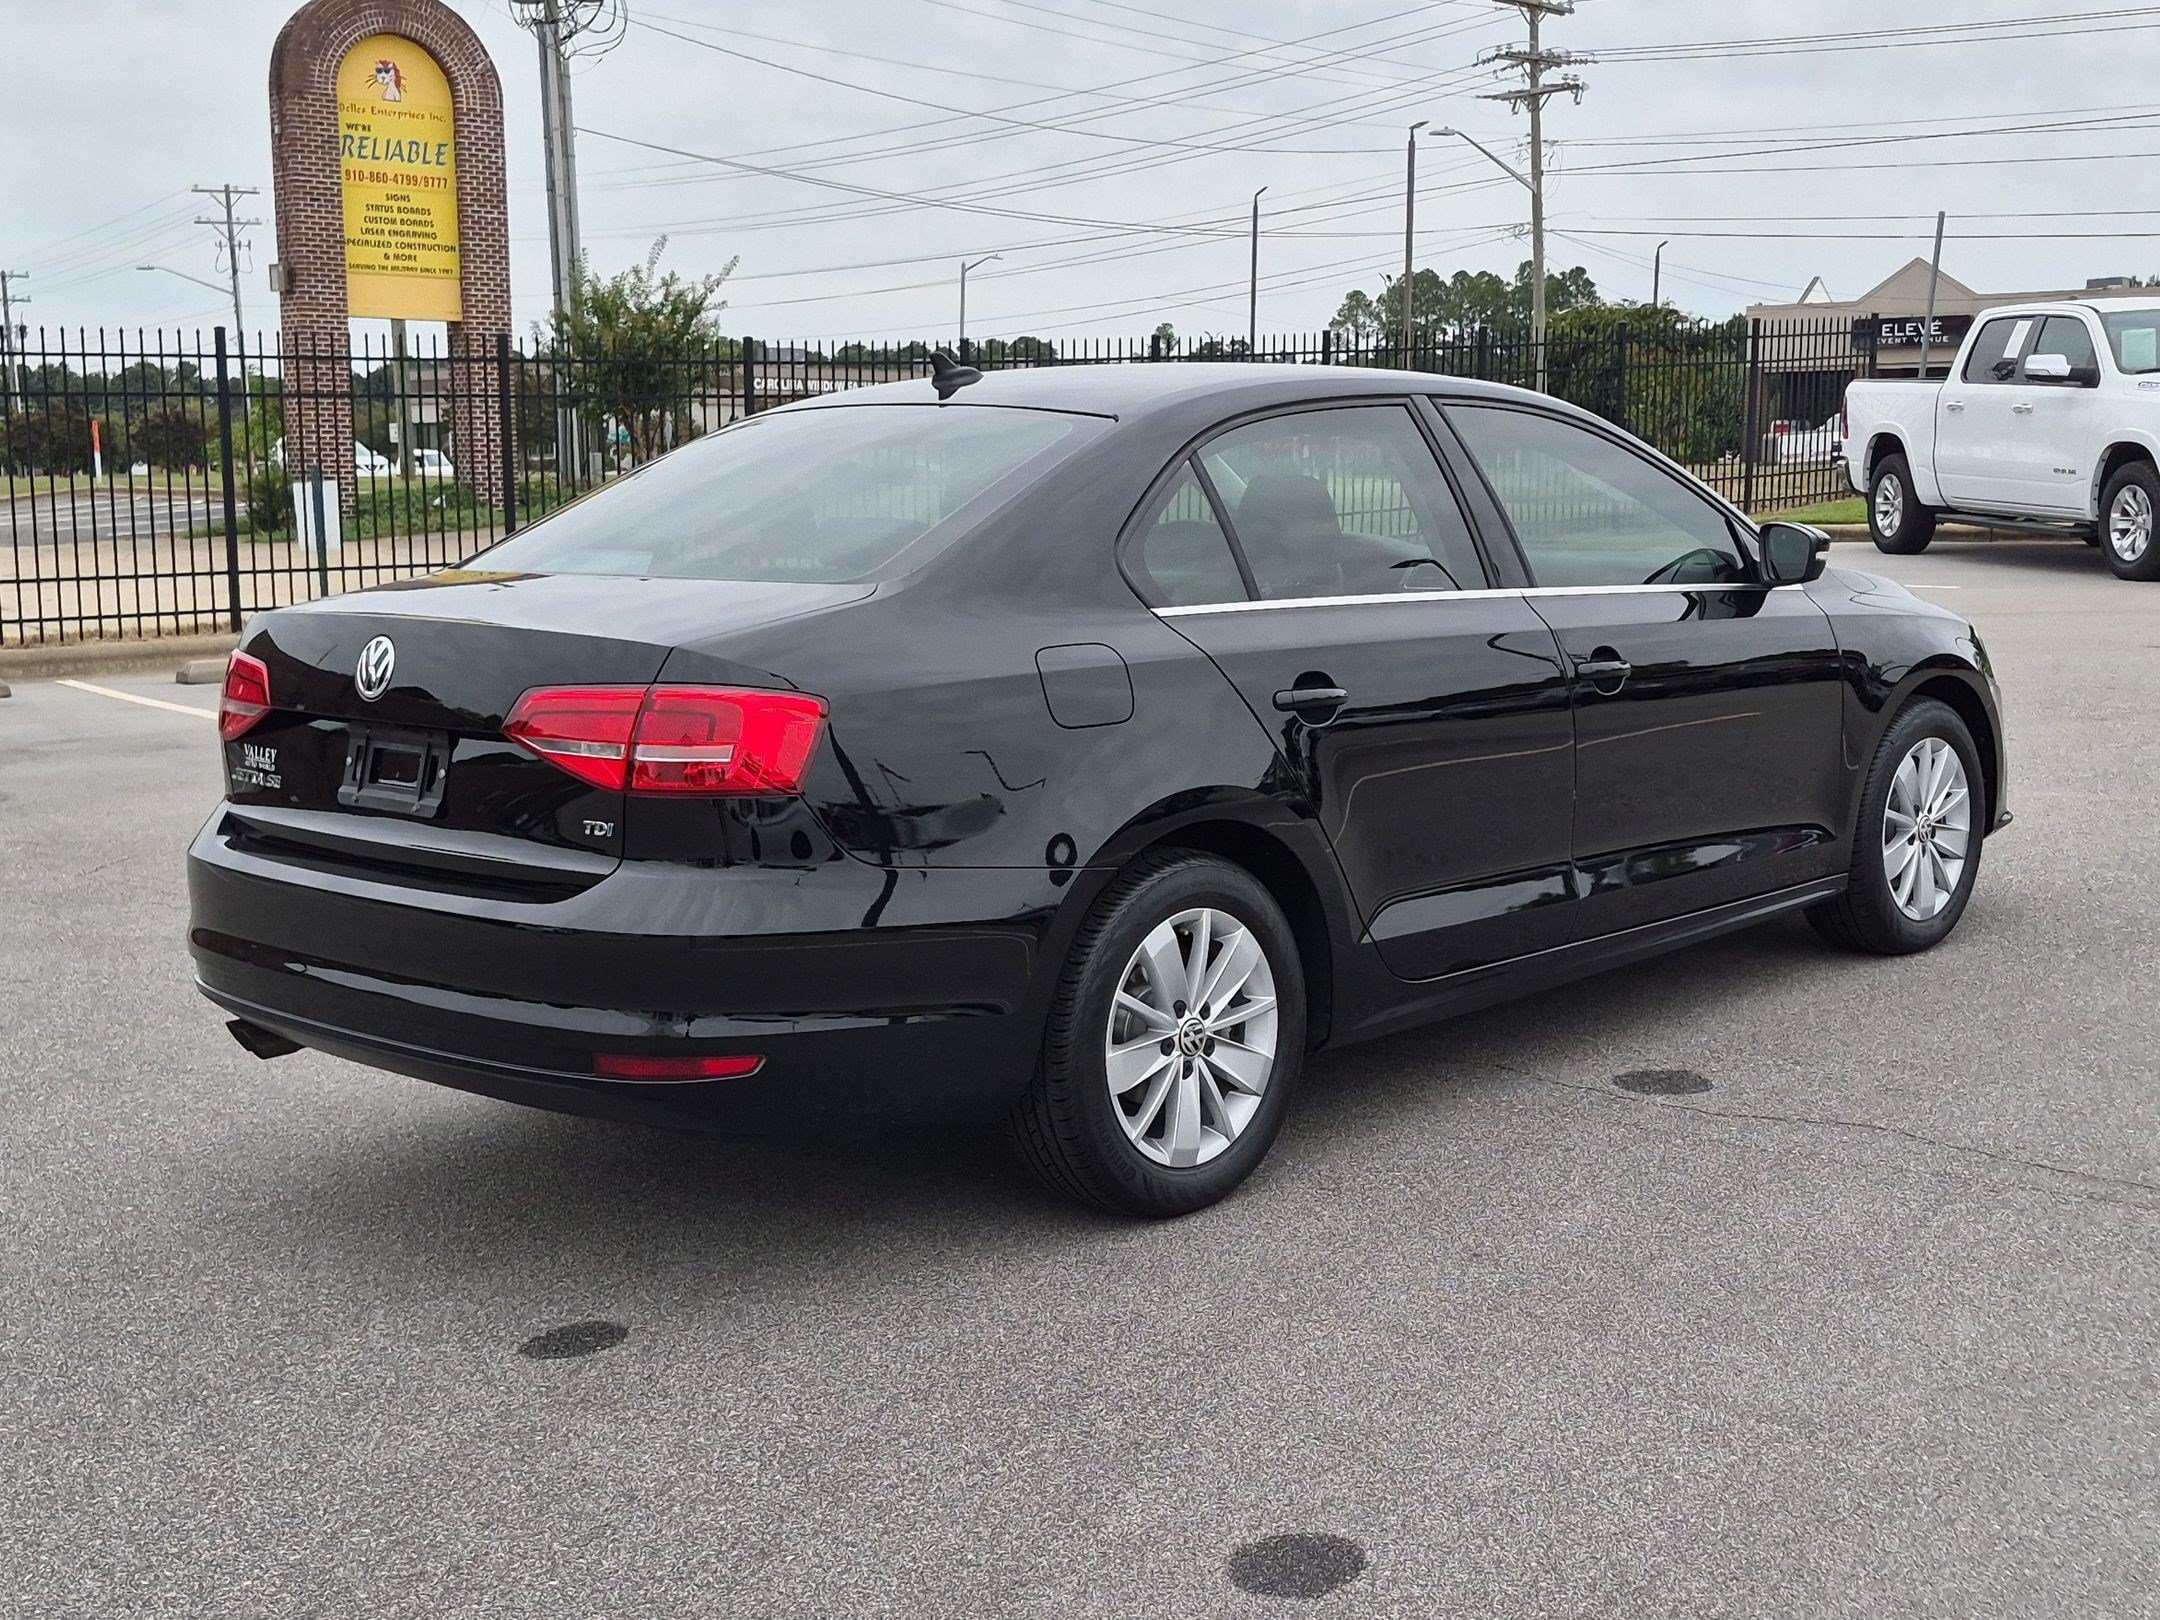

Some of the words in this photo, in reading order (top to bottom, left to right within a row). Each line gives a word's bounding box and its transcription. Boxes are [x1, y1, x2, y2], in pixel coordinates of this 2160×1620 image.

[371, 106, 425, 120] Enterprises
[429, 112, 447, 123] Inc.
[341, 134, 449, 166] RELIABLE
[344, 169, 449, 189] 910-860-4799/9777
[385, 193, 411, 203] SIGNS
[365, 203, 395, 214] STATUS
[396, 206, 432, 217] BOARDS
[363, 215, 398, 226] CUSTOM
[399, 218, 435, 228] BOARDS
[360, 227, 386, 237] LASER
[388, 229, 438, 240] ENGRAVING
[346, 238, 392, 249] PECIALIZED
[395, 241, 457, 253] CONSTRUCTION
[392, 253, 418, 262] MORE
[348, 263, 376, 271] SERVING
[378, 264, 389, 272] THE
[244, 743, 277, 763] VALLEY
[582, 819, 614, 837] TDI
